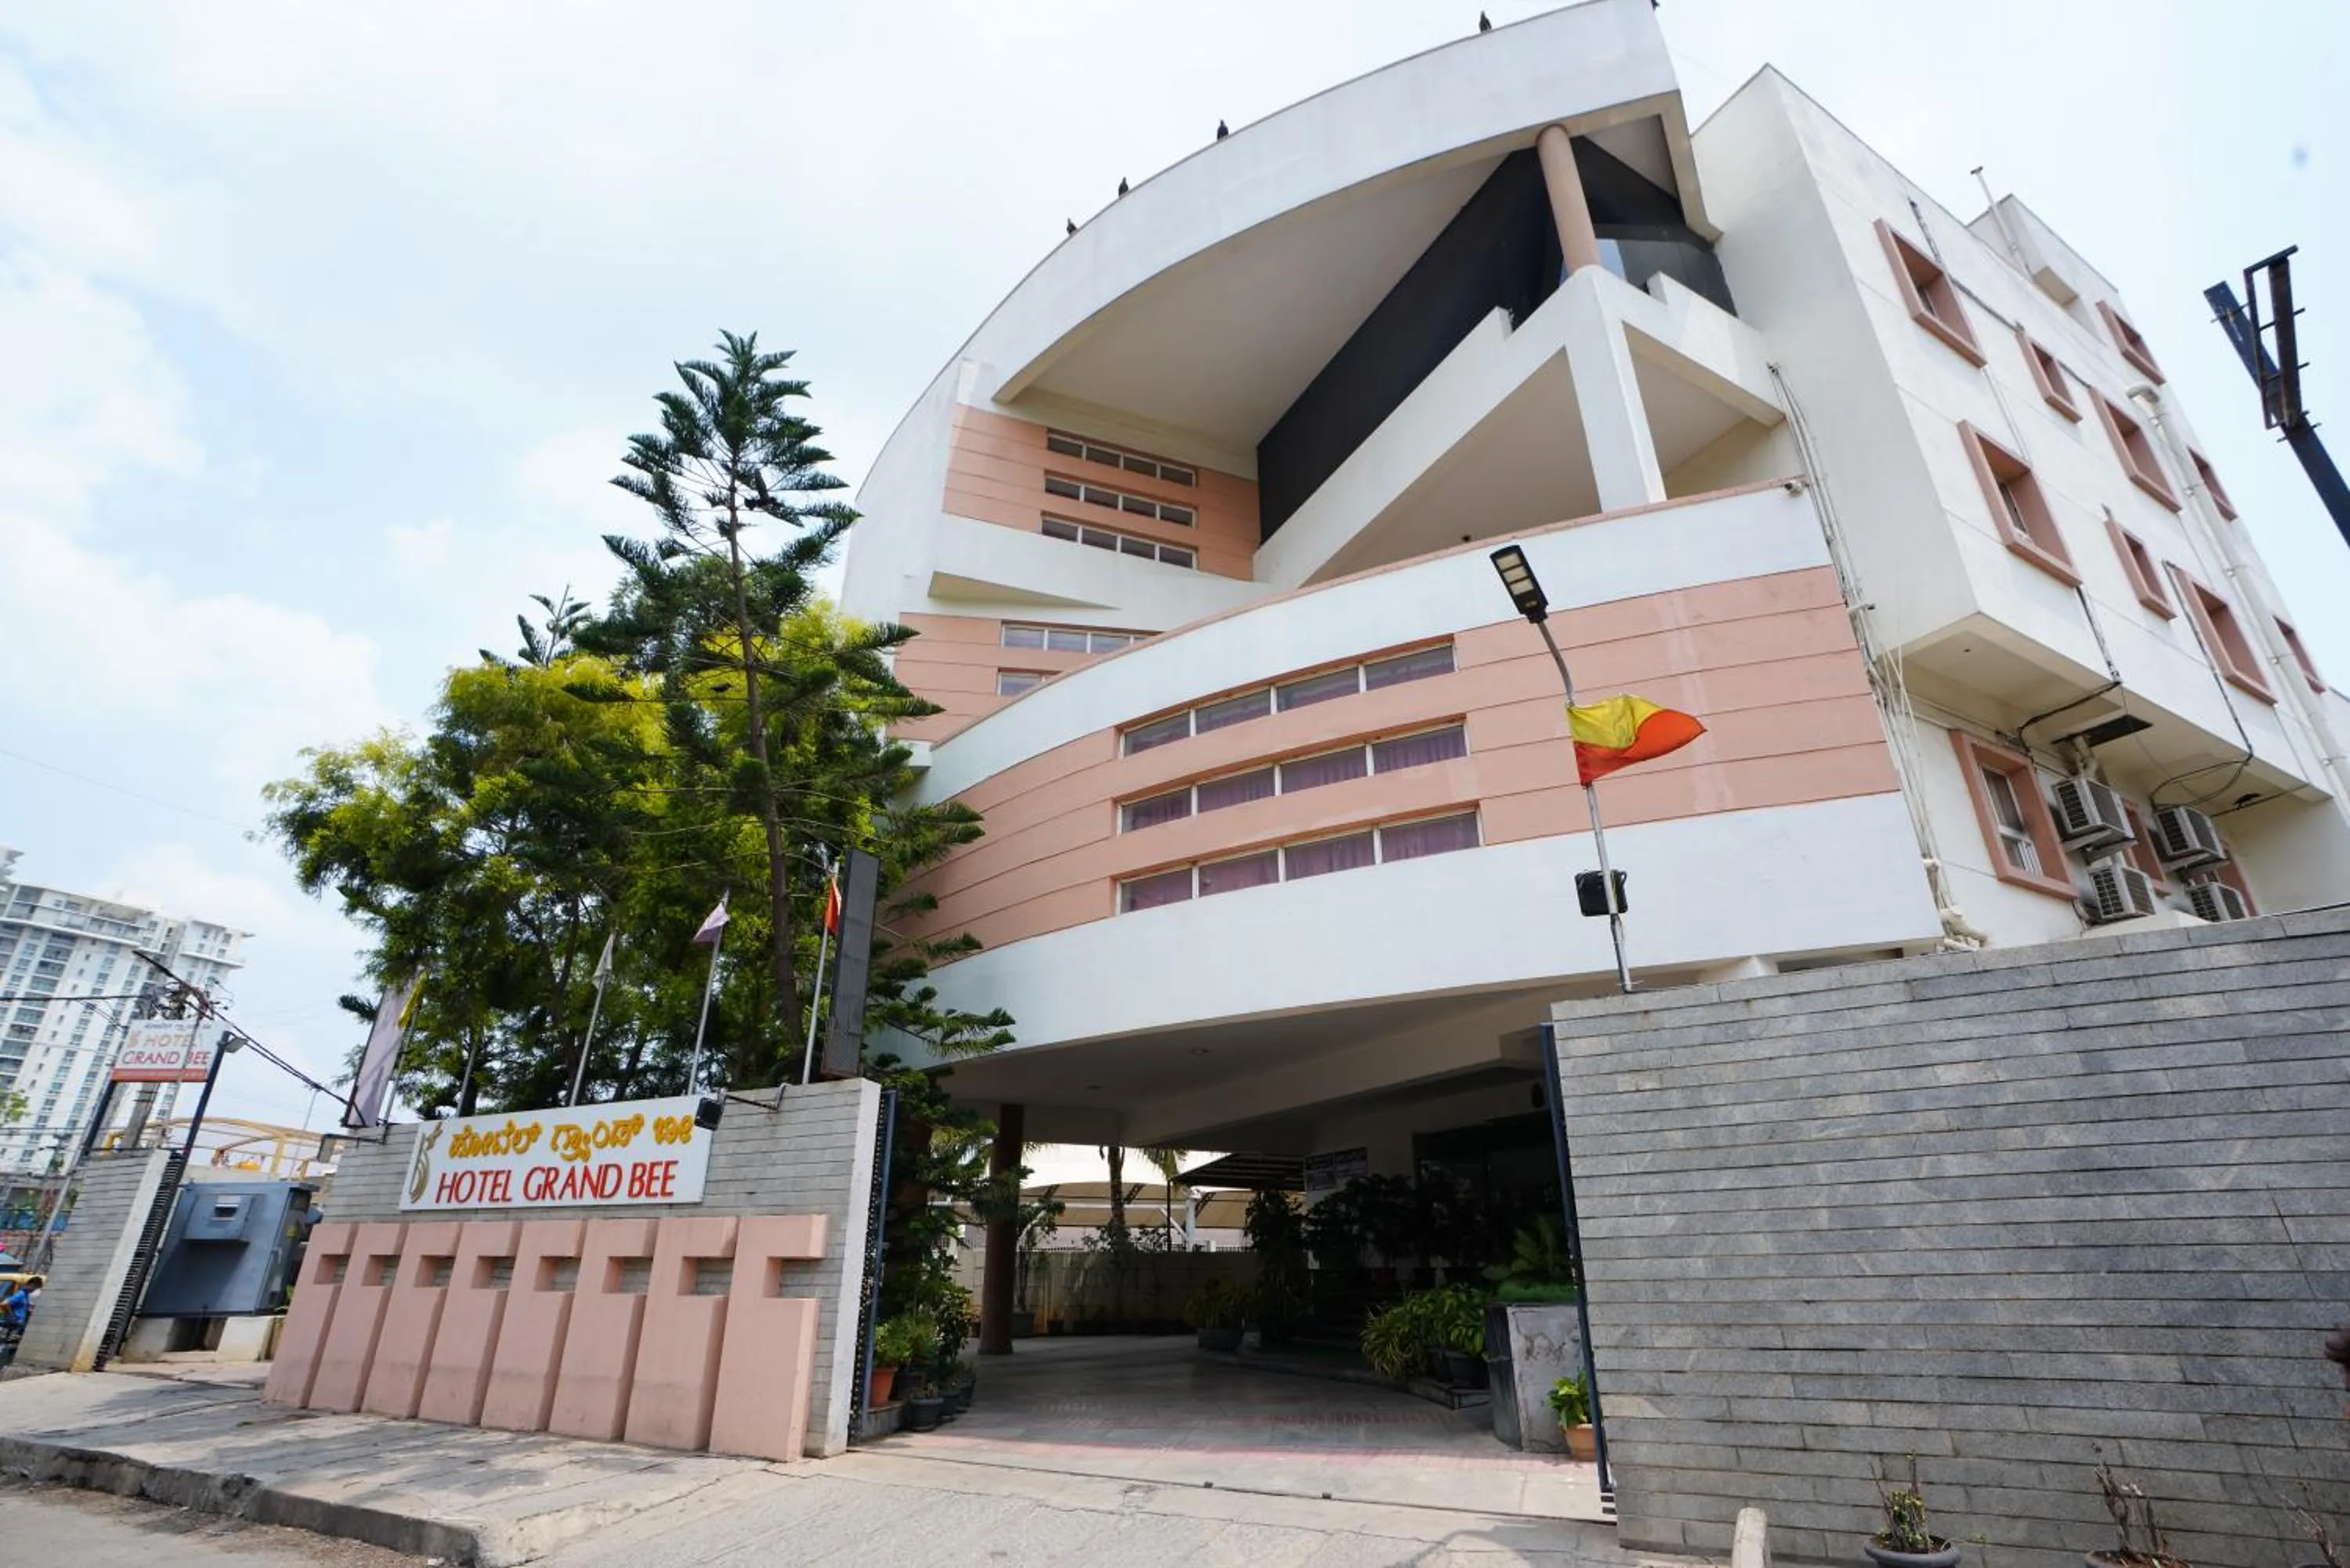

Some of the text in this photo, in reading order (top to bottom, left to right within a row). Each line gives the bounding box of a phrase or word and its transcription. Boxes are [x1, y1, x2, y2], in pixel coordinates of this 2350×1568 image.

[122, 1050, 179, 1064] GRAND
[449, 1119, 542, 1158] ಹೋಟೆಲ್
[435, 1160, 679, 1204] HOTEL GRAND BEE
